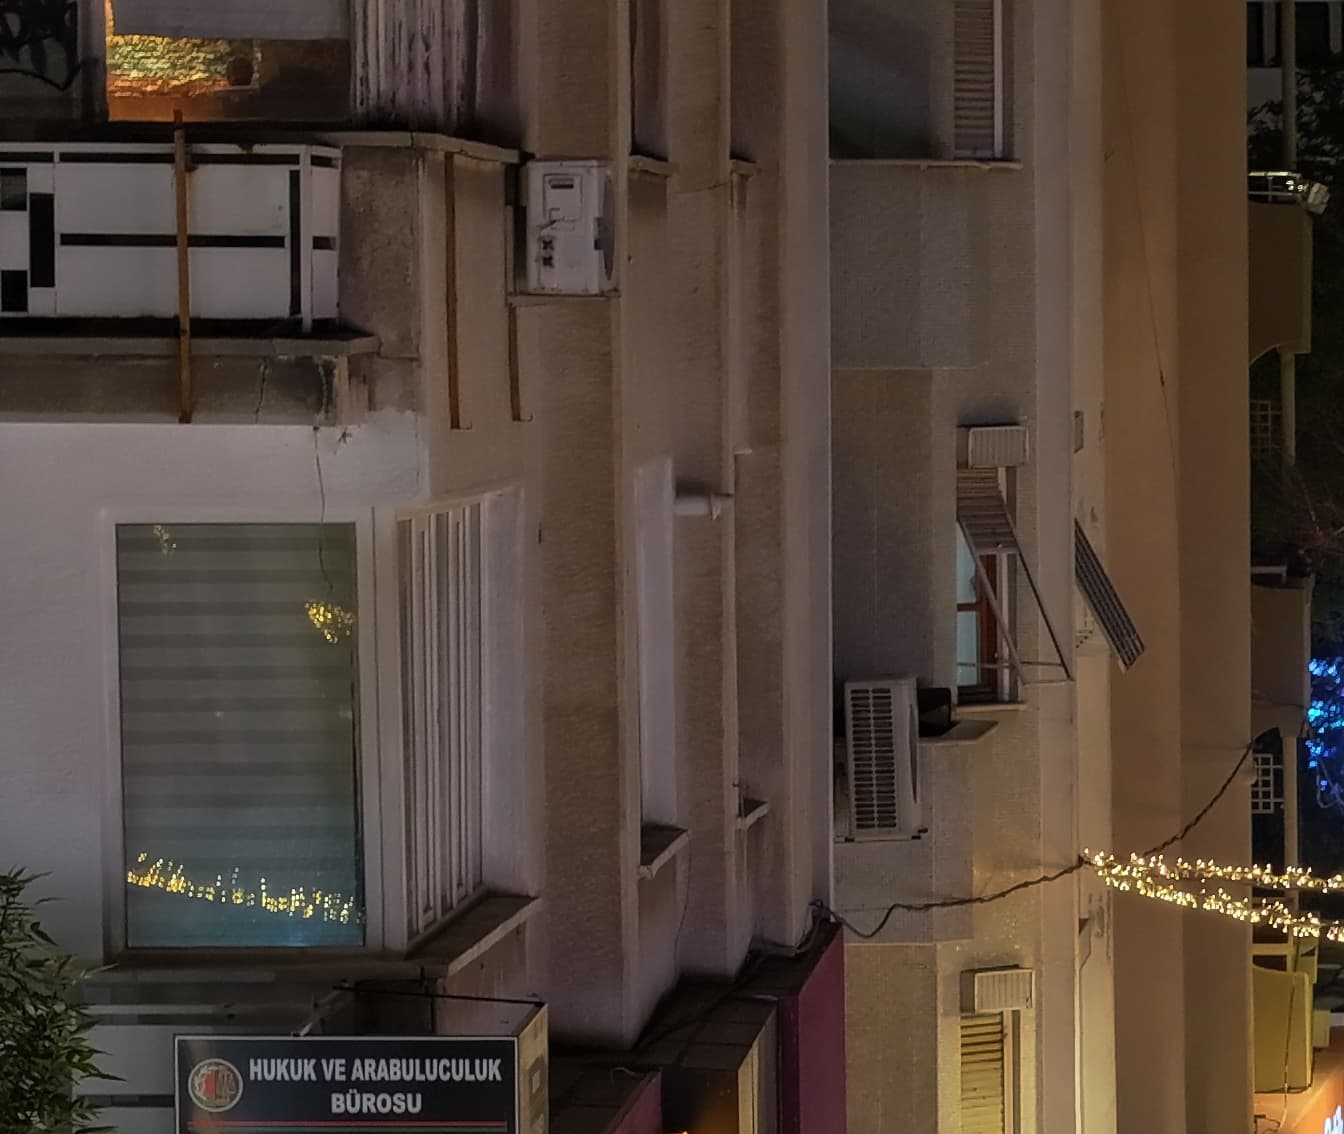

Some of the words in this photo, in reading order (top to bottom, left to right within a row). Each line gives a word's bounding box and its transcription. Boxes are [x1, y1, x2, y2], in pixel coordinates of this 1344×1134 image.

[249, 1058, 317, 1082] HUKUK
[321, 1058, 347, 1081] VE
[351, 1058, 502, 1082] ARABULUCULUK
[331, 1089, 422, 1114] BÜROSU
